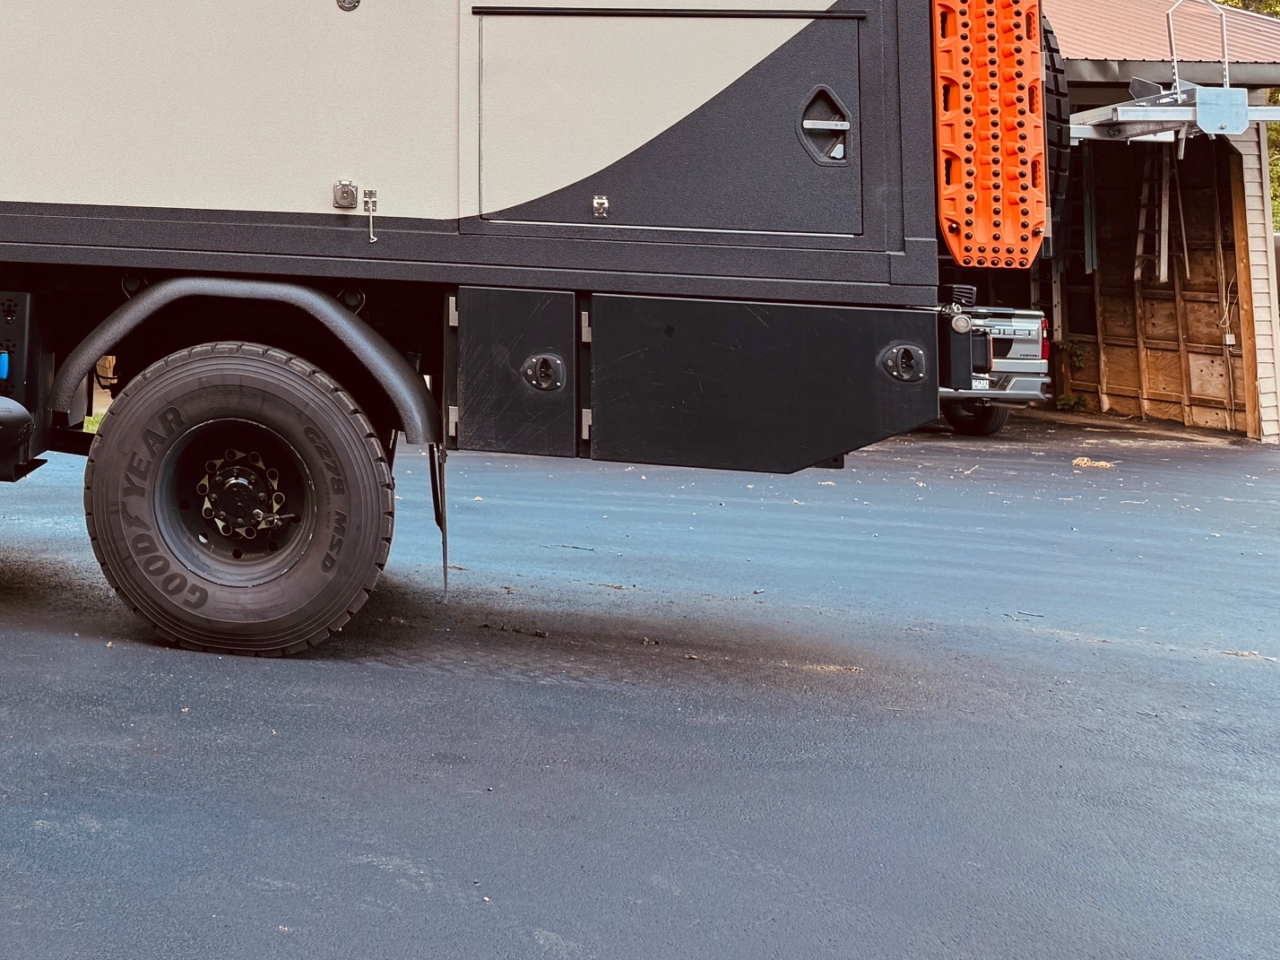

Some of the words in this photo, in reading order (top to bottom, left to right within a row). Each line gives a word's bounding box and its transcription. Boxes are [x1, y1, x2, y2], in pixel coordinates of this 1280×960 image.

[303, 426, 346, 495] G278
[120, 406, 209, 610] GOODYEAR
[321, 510, 348, 573] MSD
